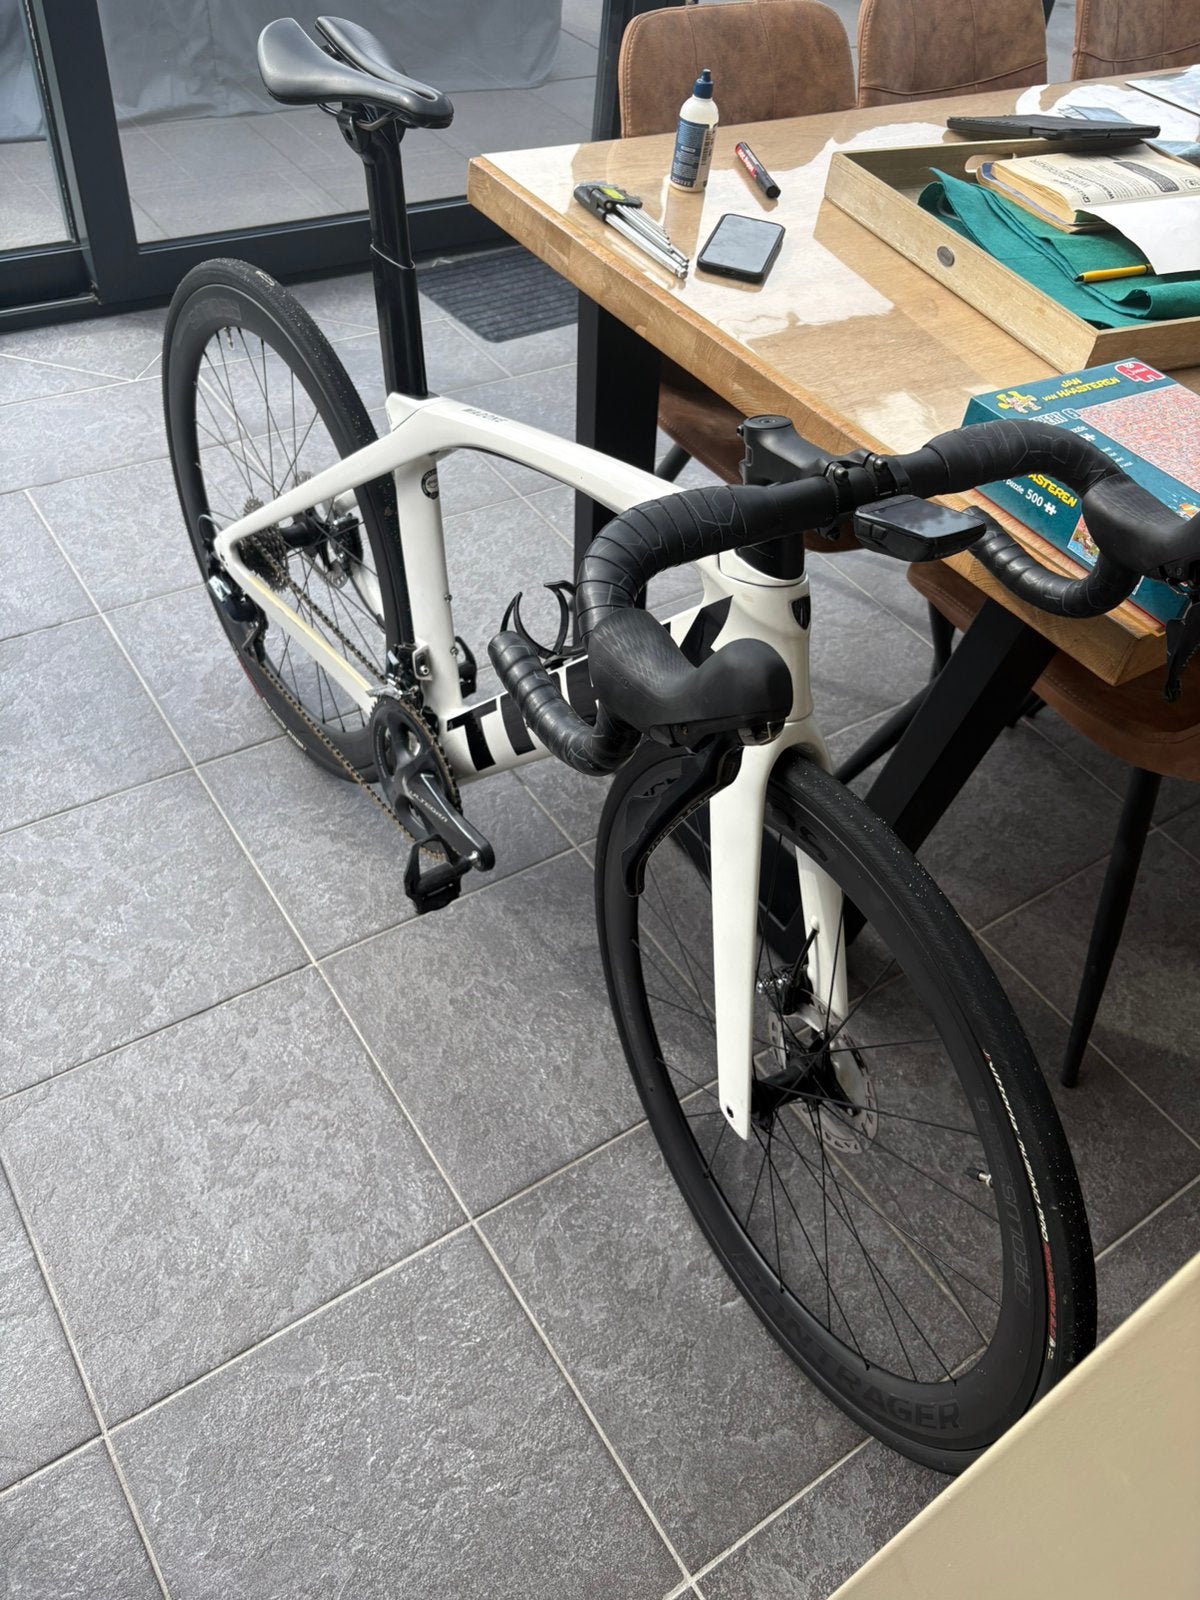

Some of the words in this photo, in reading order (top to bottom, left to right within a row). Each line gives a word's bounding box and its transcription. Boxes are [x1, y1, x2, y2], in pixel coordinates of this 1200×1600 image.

[1057, 377, 1120, 398] HAASTEREN
[1061, 378, 1082, 388] JAN
[1024, 488, 1044, 508] 500
[1028, 473, 1077, 508] ASTEREN
[1002, 1183, 1032, 1292] AEOLUS
